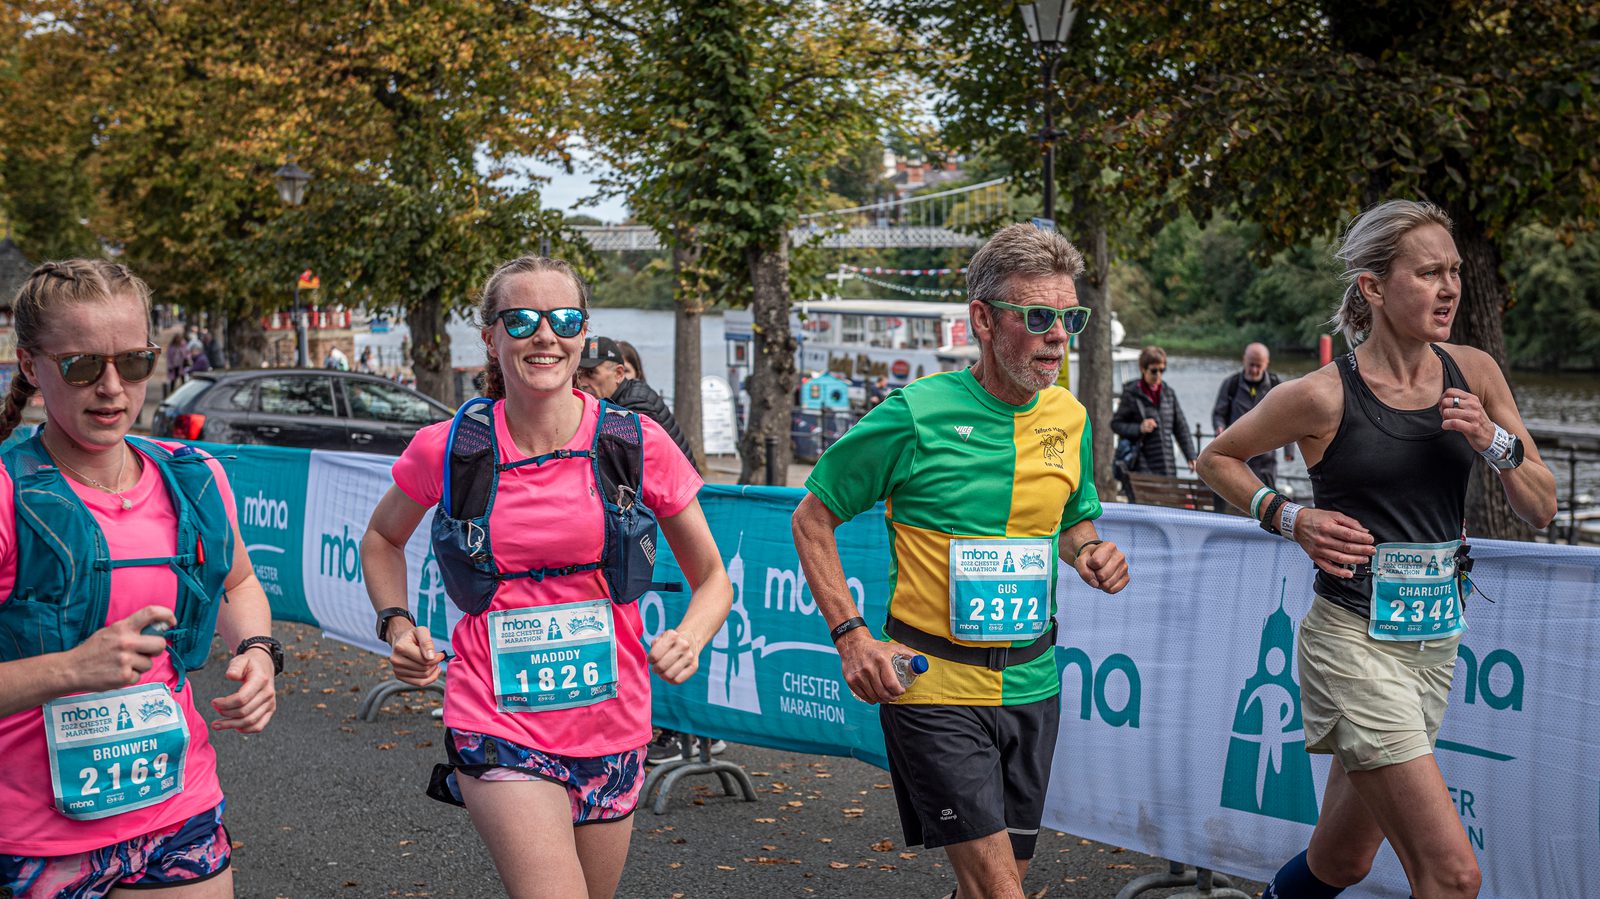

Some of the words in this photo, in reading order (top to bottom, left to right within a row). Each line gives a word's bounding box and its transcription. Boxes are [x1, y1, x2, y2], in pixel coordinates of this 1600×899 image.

[243, 490, 288, 530] mbna
[320, 525, 362, 583] mb
[962, 549, 999, 560] mbna
[1385, 552, 1422, 563] mbna
[764, 560, 864, 618] mba
[997, 584, 1017, 594] GUS
[1398, 584, 1452, 597] CHARLOTTE
[969, 597, 1039, 621] 2372
[1390, 597, 1454, 623] 2342
[502, 618, 541, 632] mbna
[516, 629, 544, 637] CHESTER
[504, 635, 541, 644] MARATHON
[530, 649, 581, 665] MADDDY
[516, 662, 599, 693] 1826
[782, 672, 840, 701] CHESTER
[1055, 645, 1141, 728] na
[1457, 644, 1524, 711] na
[61, 705, 109, 723] mbna
[780, 696, 845, 724] MARATHON
[61, 723, 78, 731] 2022
[80, 718, 112, 728] CHESTER
[65, 726, 110, 737] MARATHON
[93, 738, 158, 761] BRONWEN
[79, 753, 169, 796] 2169
[70, 800, 94, 809] mbna
